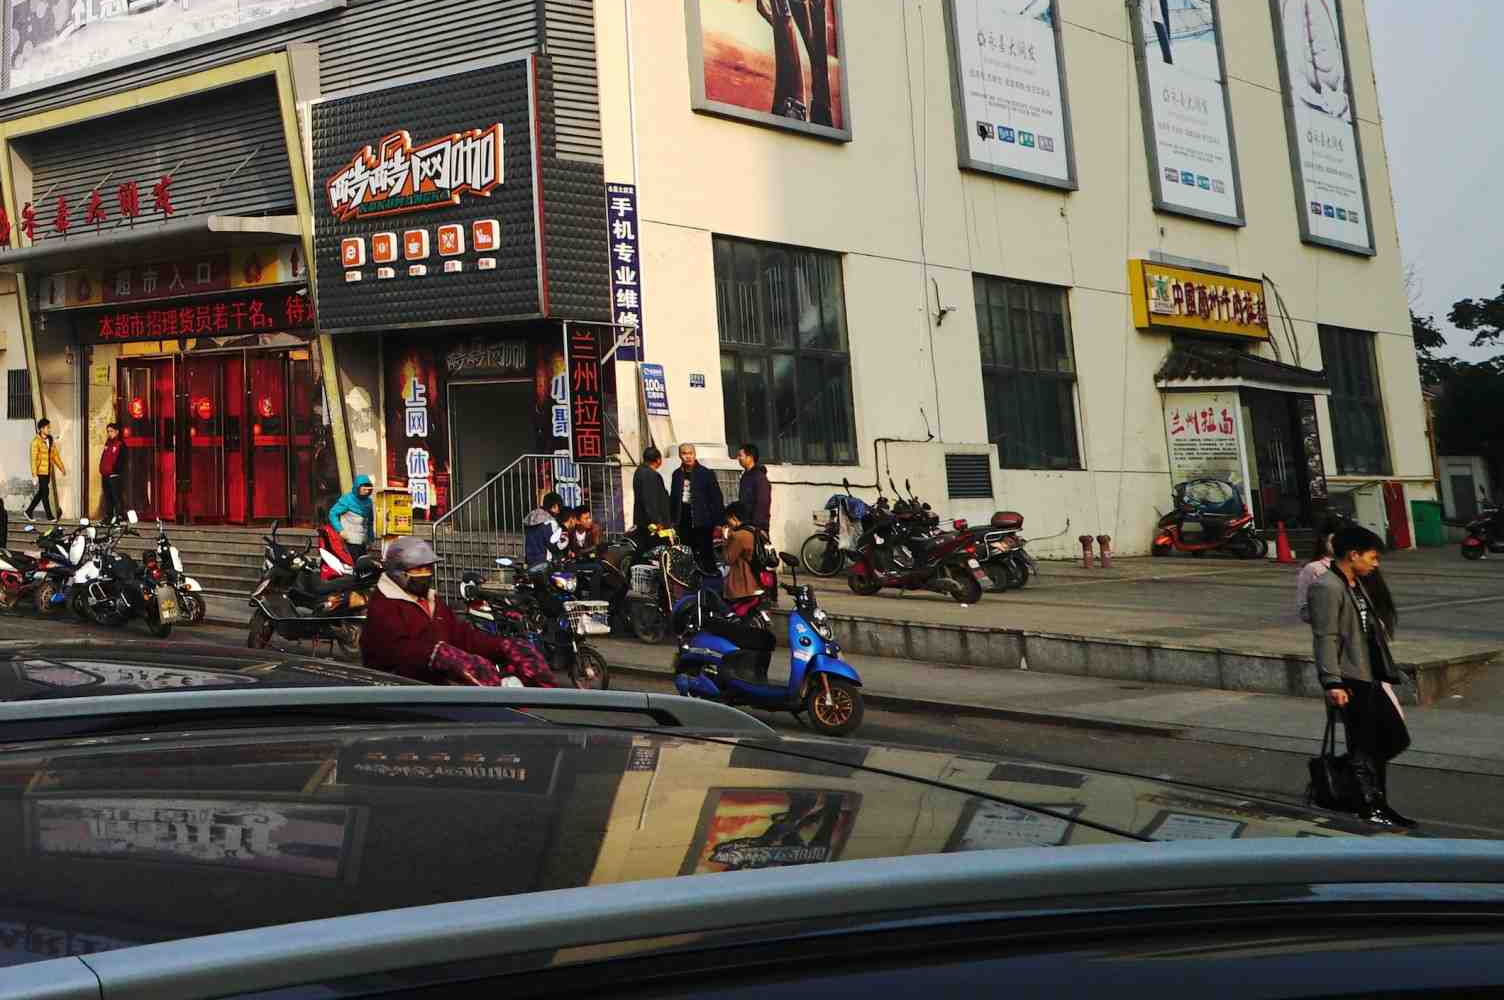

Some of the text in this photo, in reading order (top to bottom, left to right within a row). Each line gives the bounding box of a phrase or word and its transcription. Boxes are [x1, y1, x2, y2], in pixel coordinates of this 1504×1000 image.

[329, 132, 495, 210] 酷酷网咖
[115, 263, 212, 297] 超市入口
[610, 197, 640, 331] 手机专业维修
[571, 331, 601, 457] 兰州拉面
